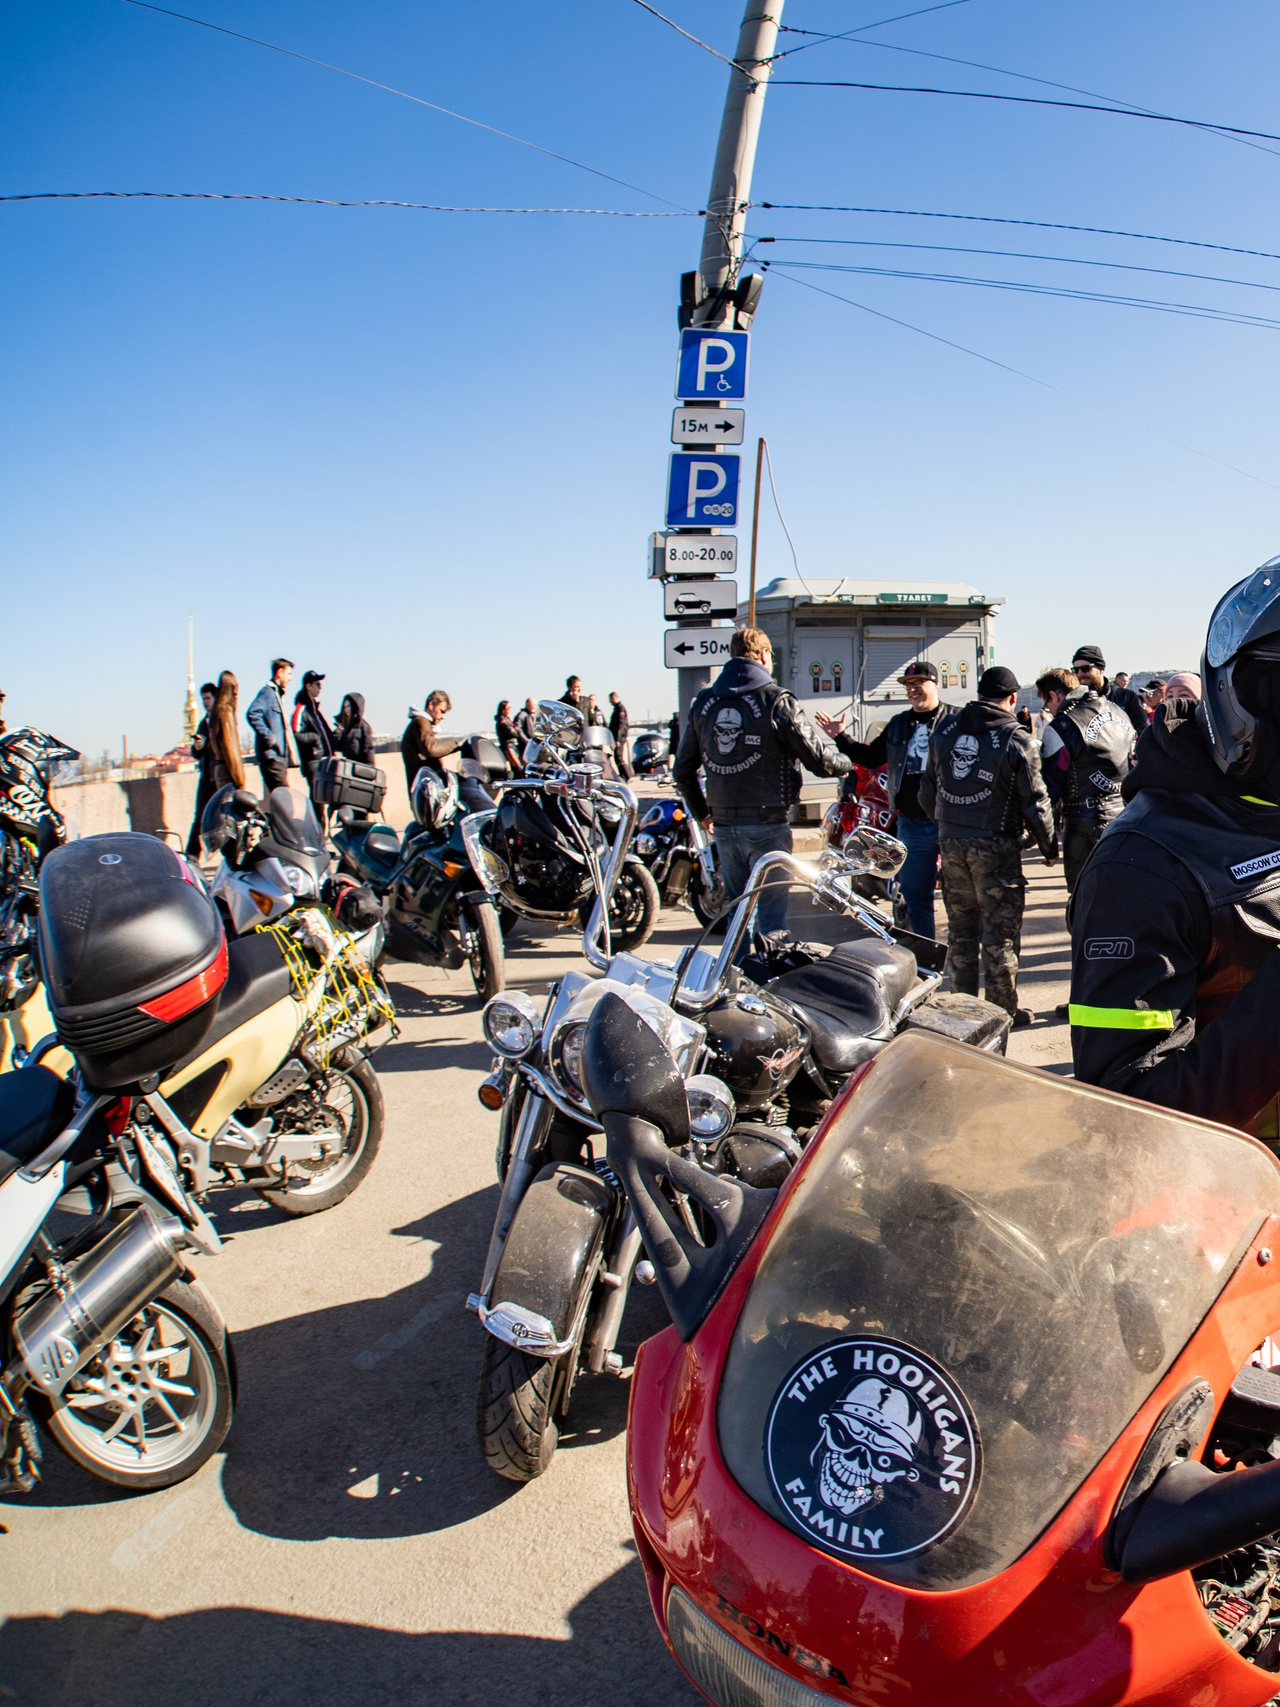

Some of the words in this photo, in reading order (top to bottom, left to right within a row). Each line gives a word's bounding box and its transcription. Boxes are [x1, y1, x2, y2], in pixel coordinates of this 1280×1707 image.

[696, 338, 735, 391] P
[687, 462, 726, 518] P
[721, 506, 732, 514] 20
[670, 548, 733, 561] 8.00-20.00
[897, 594, 932, 602] ТУАЛЕТ
[701, 697, 715, 716] THE
[1233, 858, 1271, 877] MOSCOW
[1089, 942, 1128, 956] FRM
[787, 1356, 839, 1403] THE
[853, 1349, 967, 1496] HOOLIGANS
[785, 1477, 885, 1549] FAMILY
[716, 1594, 853, 1690] HONDA
